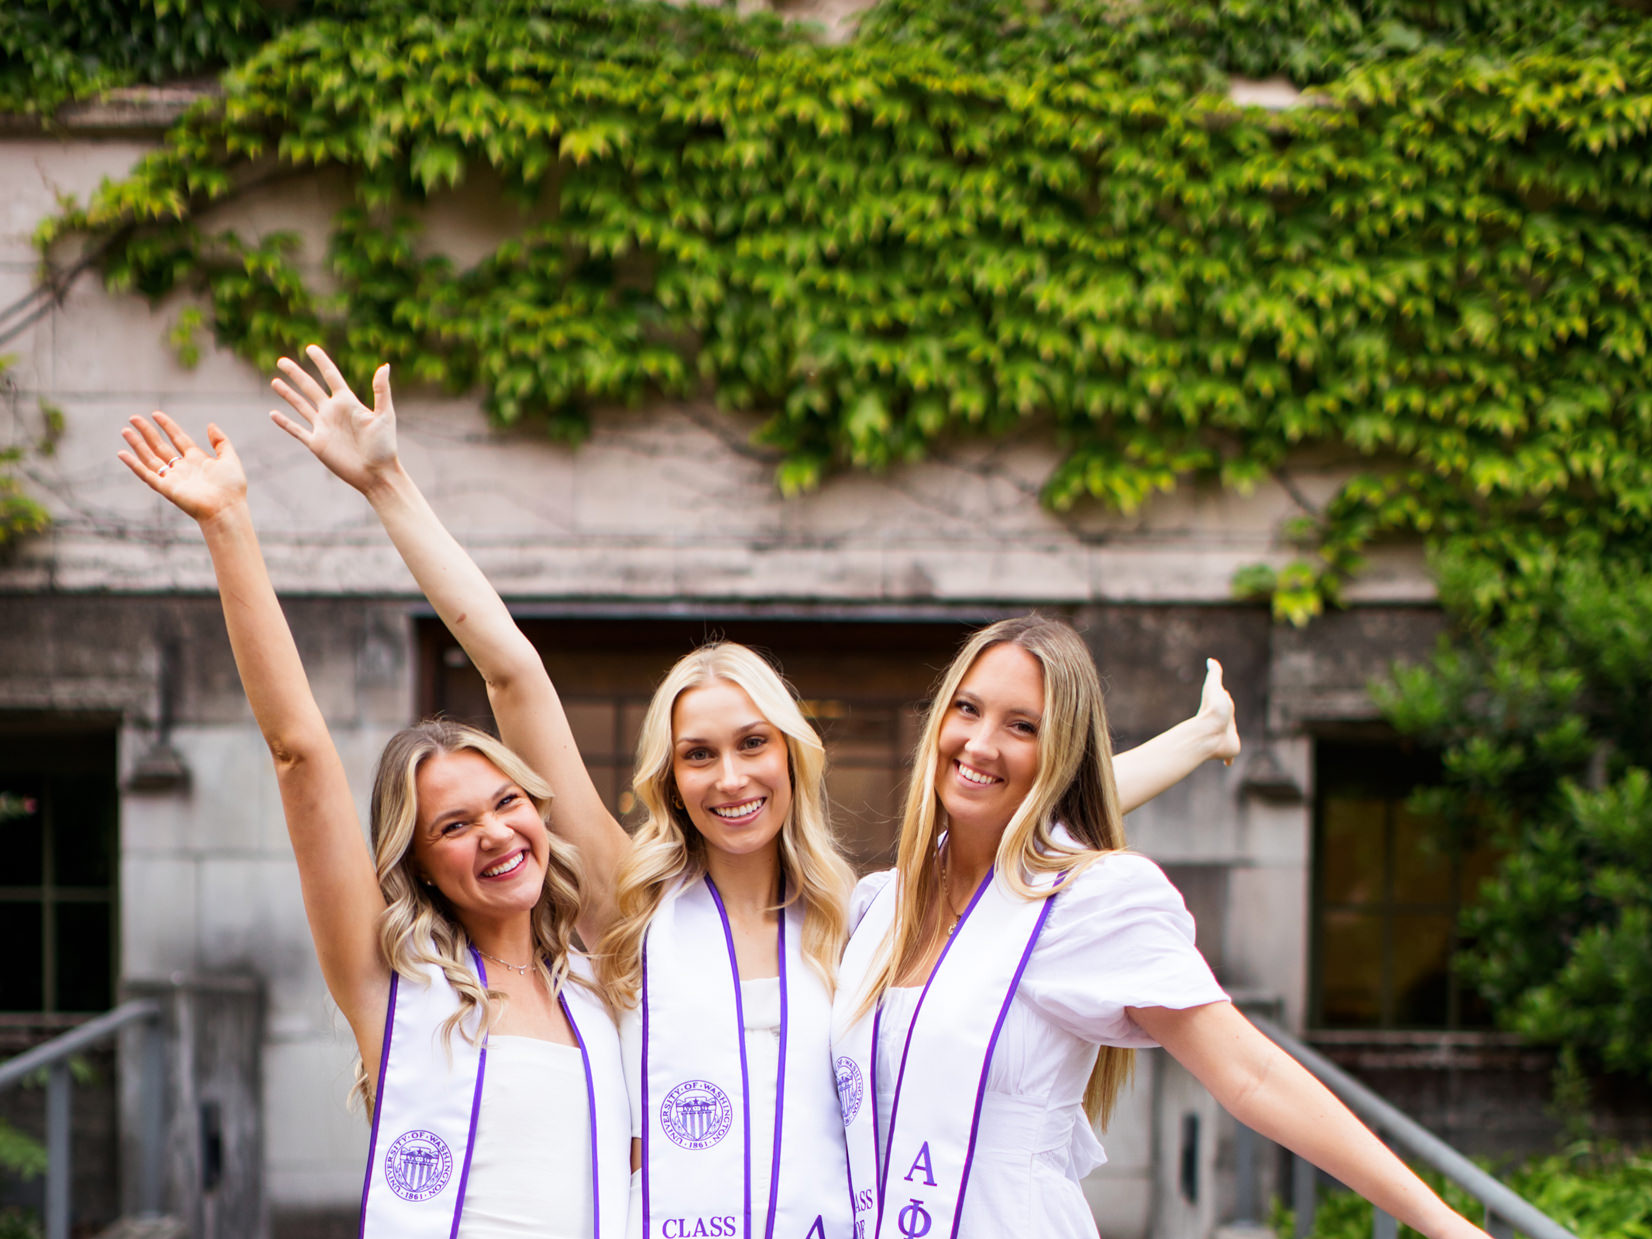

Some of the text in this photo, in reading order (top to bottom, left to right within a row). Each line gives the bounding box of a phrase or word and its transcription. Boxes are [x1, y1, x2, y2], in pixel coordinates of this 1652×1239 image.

[662, 1082, 731, 1145] UNIVERSITY OF WASHINGTON
[689, 1141, 708, 1149] 1861
[386, 1131, 451, 1196] UNIVERSITY OF WASHINGTON
[405, 1192, 423, 1200] 1861
[855, 1189, 873, 1213] ASS
[662, 1216, 736, 1239] CLASS
